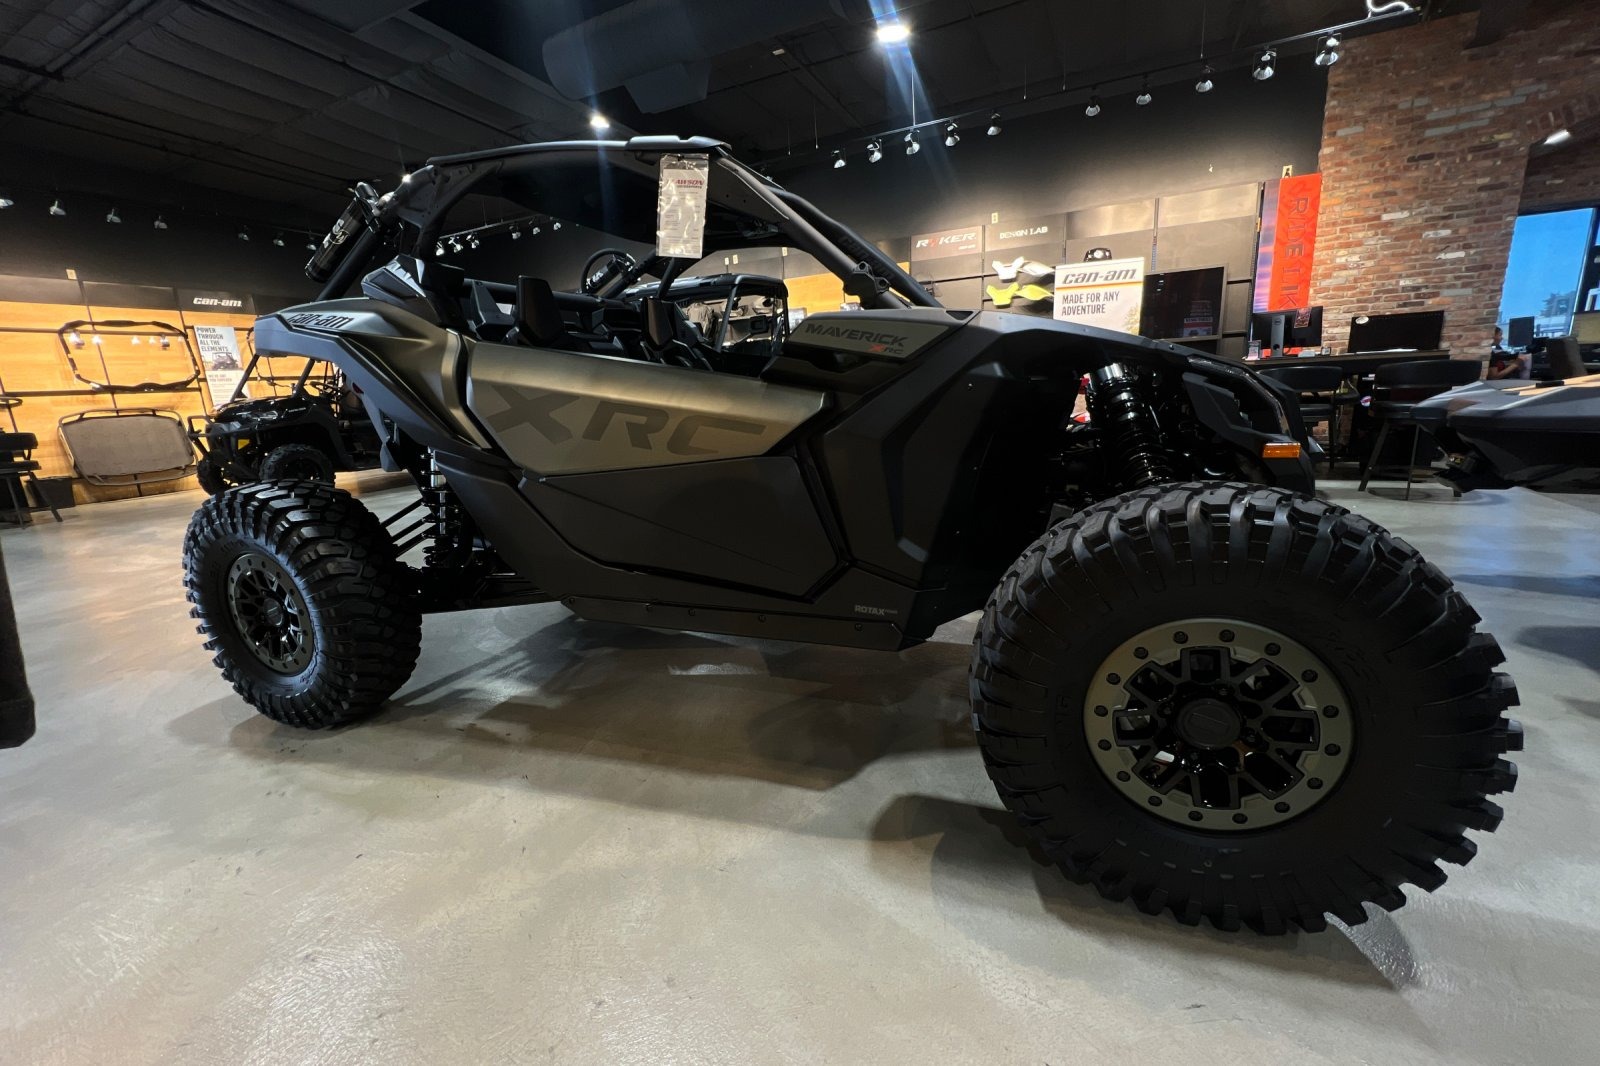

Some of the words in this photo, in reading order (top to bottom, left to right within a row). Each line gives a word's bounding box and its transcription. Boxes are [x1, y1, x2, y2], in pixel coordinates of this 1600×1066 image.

[1030, 226, 1048, 236] LAB
[1062, 268, 1137, 285] can-am
[193, 297, 242, 307] can-am
[1062, 293, 1084, 305] MADE
[1086, 292, 1101, 303] FOR
[1103, 291, 1120, 302] ANY
[1061, 303, 1106, 316] ADVENTURE
[804, 323, 909, 347] MAVERICK
[485, 382, 766, 456] XRC
[854, 604, 885, 616] ROTAX
